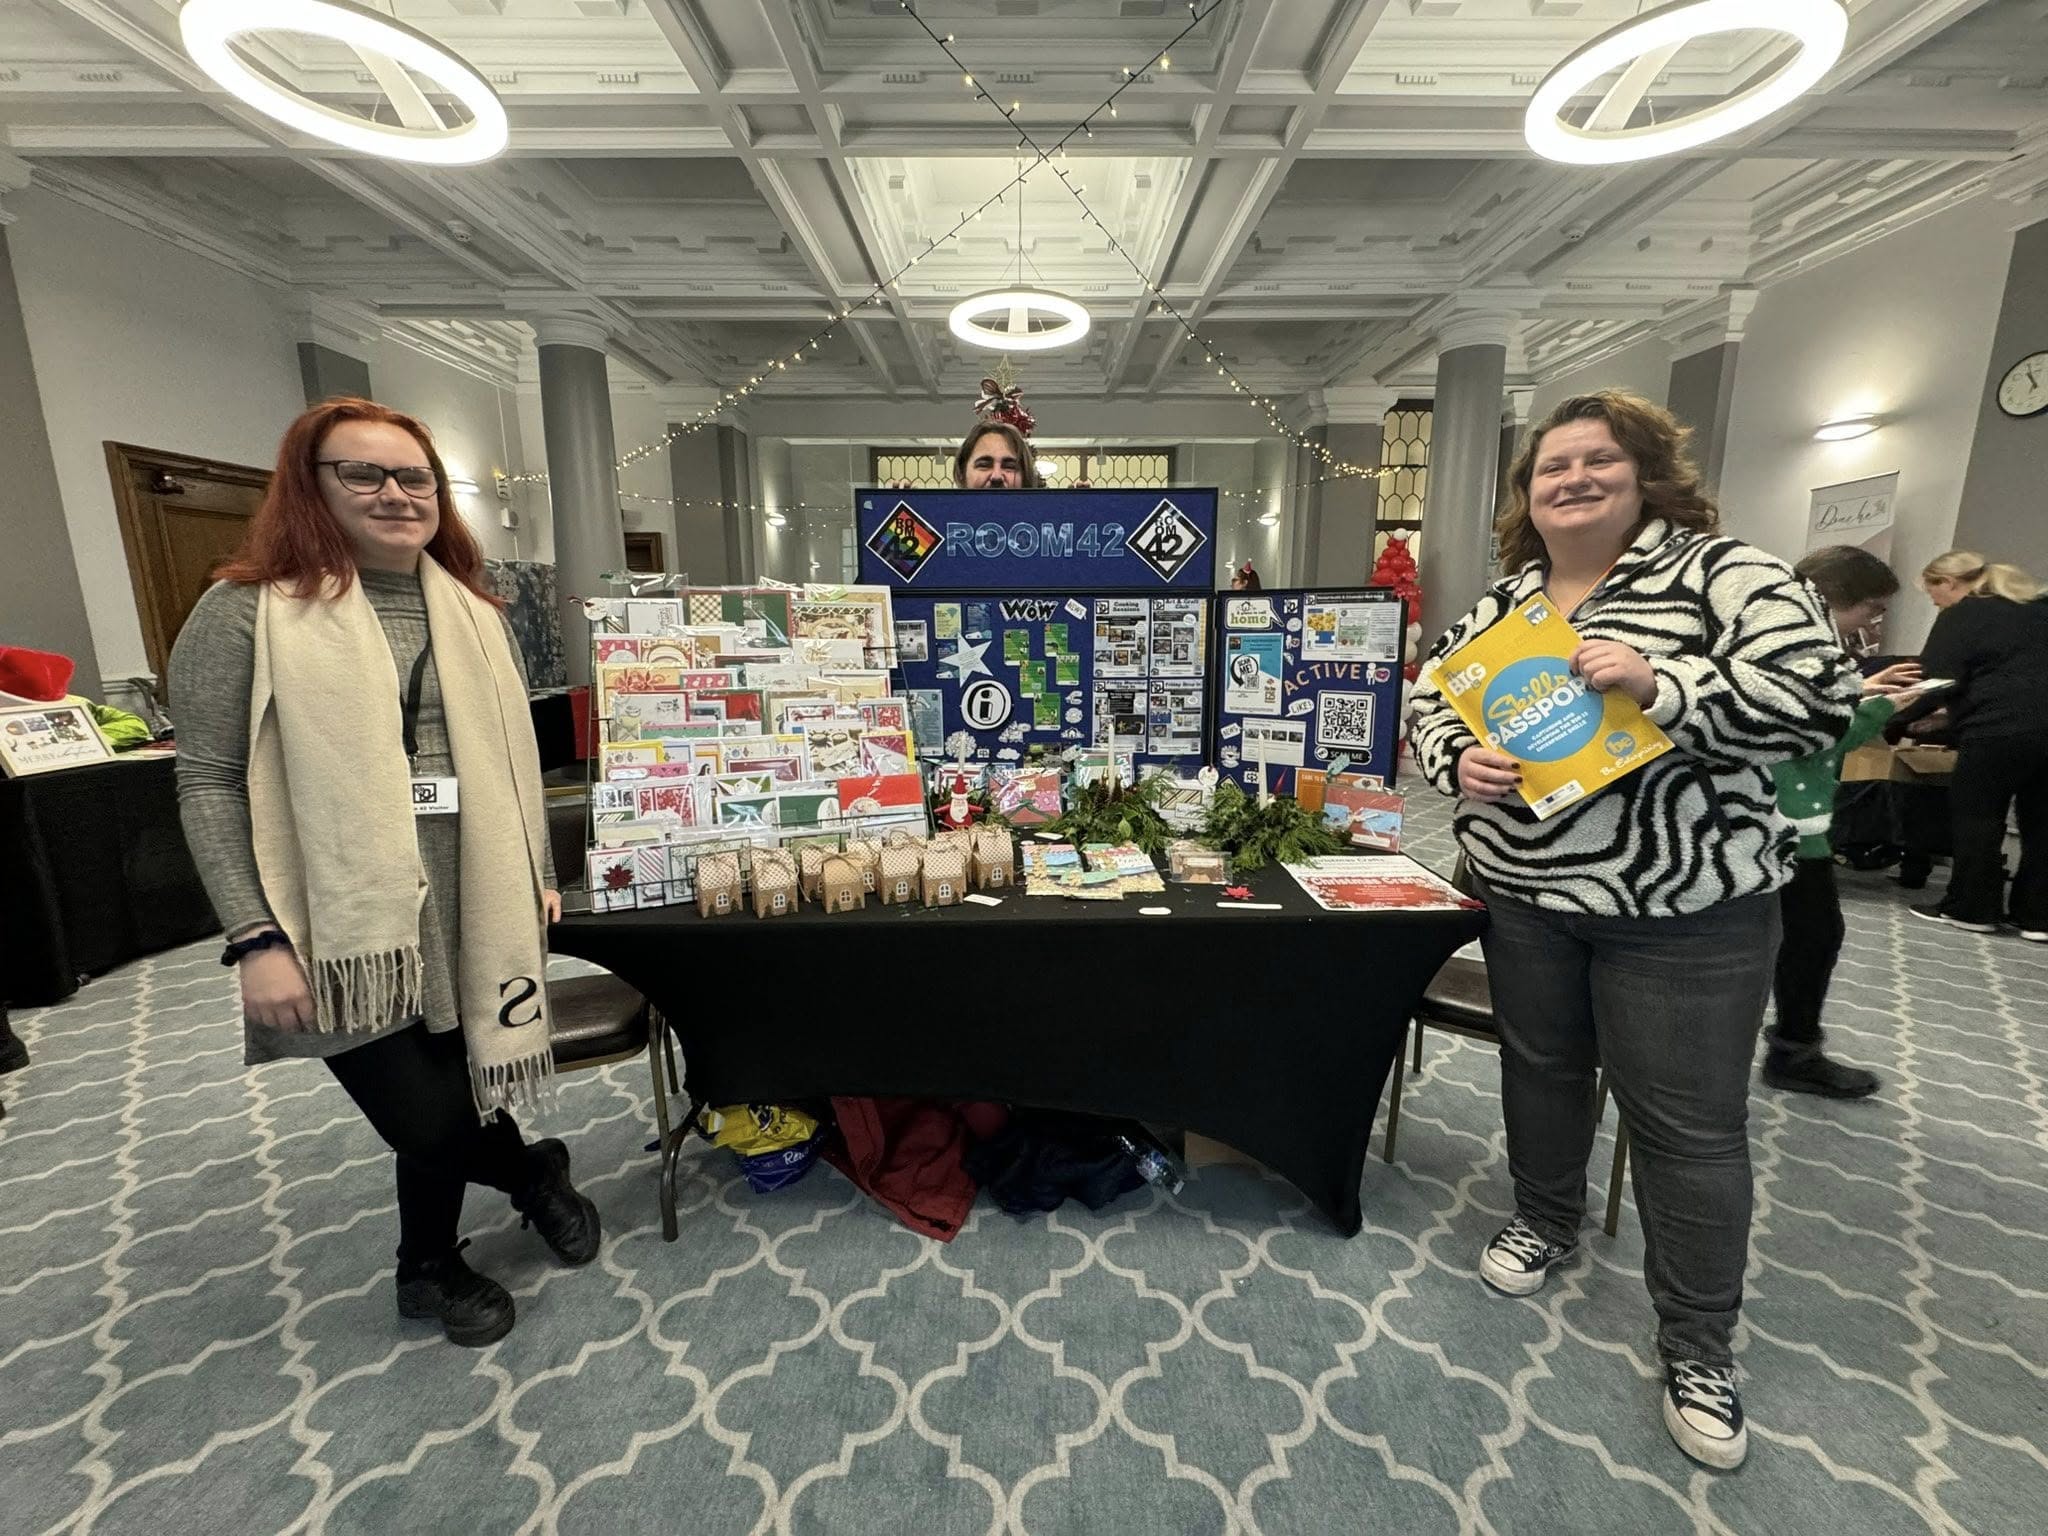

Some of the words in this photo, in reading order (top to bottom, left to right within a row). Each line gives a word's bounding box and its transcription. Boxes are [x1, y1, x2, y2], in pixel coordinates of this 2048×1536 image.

[946, 522, 1073, 557] ROOM
[1076, 522, 1125, 557] 42
[1231, 613, 1267, 624] home
[1283, 663, 1361, 696] ACTIVE
[1447, 662, 1487, 697] BIG
[1486, 676, 1586, 750] PASSPOR
